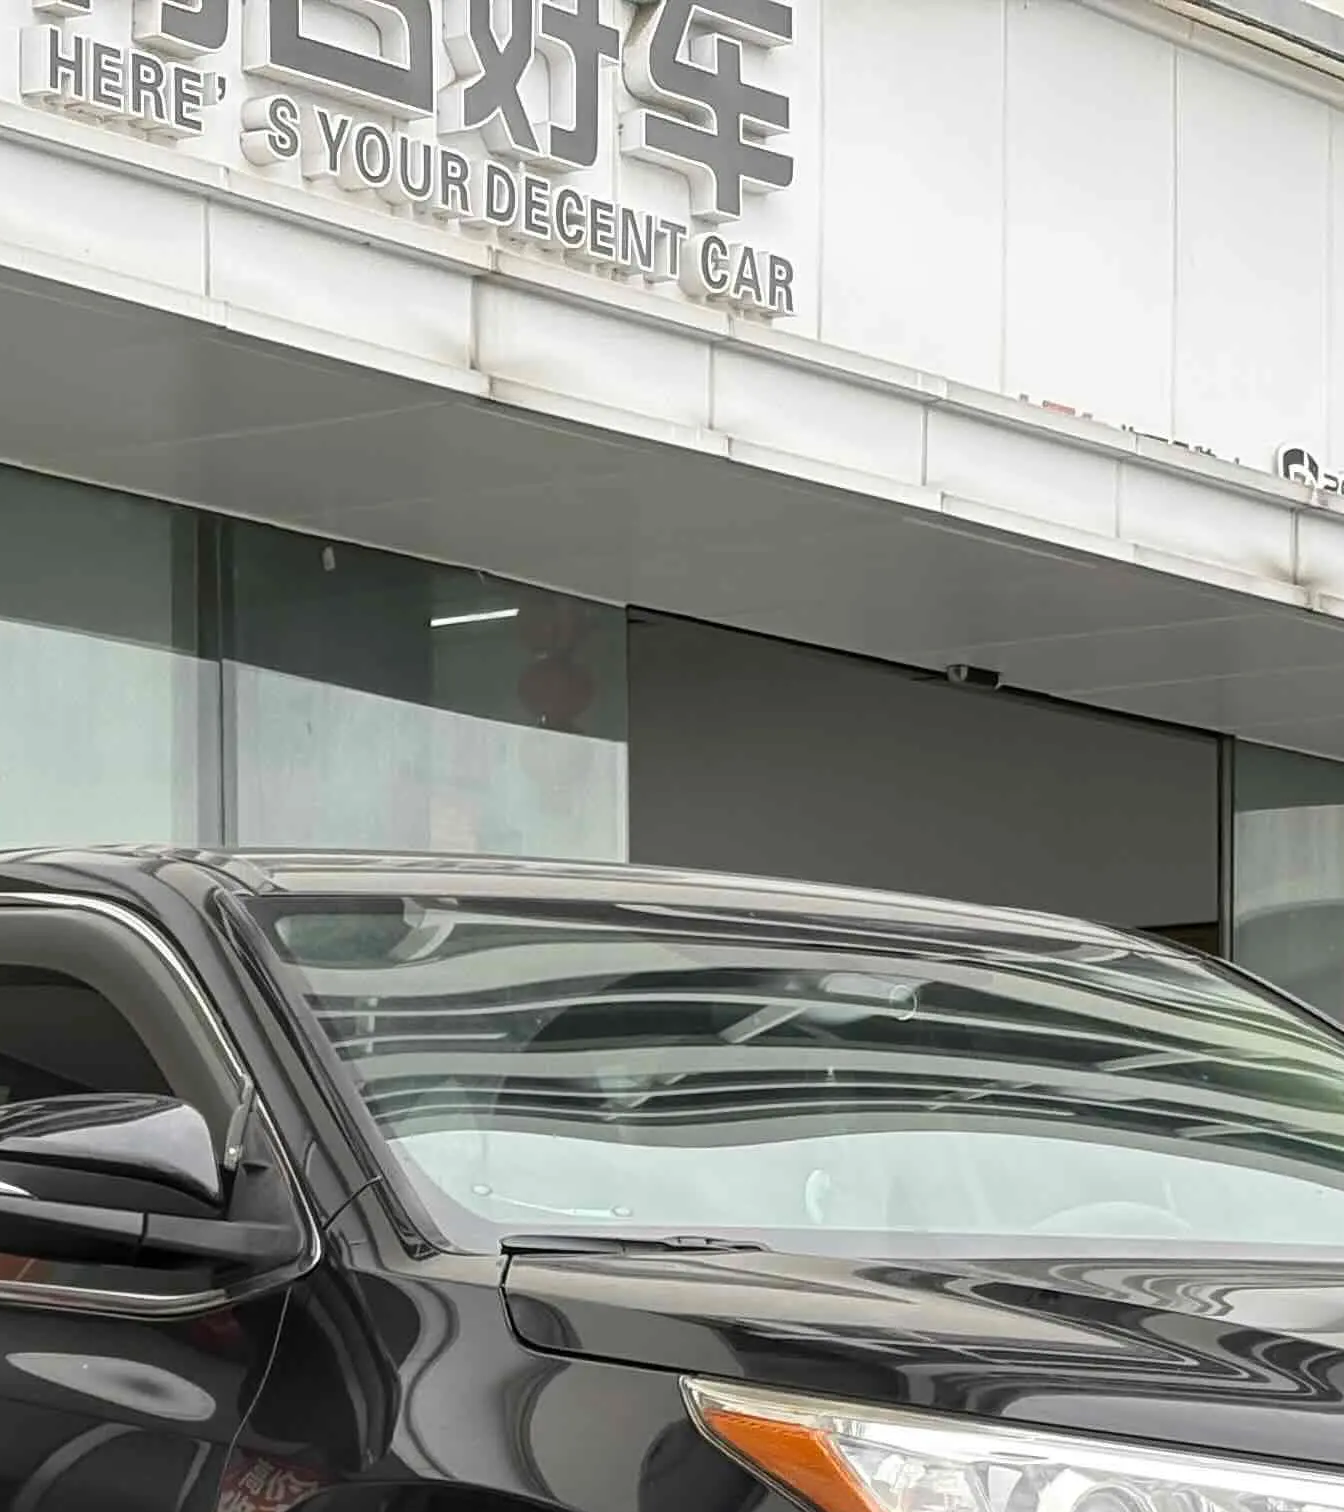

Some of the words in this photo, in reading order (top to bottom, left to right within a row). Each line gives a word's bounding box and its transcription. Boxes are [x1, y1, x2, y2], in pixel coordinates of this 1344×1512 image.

[36, 0, 794, 216] 好车
[318, 110, 469, 211] YOUR
[486, 165, 687, 276] DECENT
[701, 236, 794, 312] CAR
